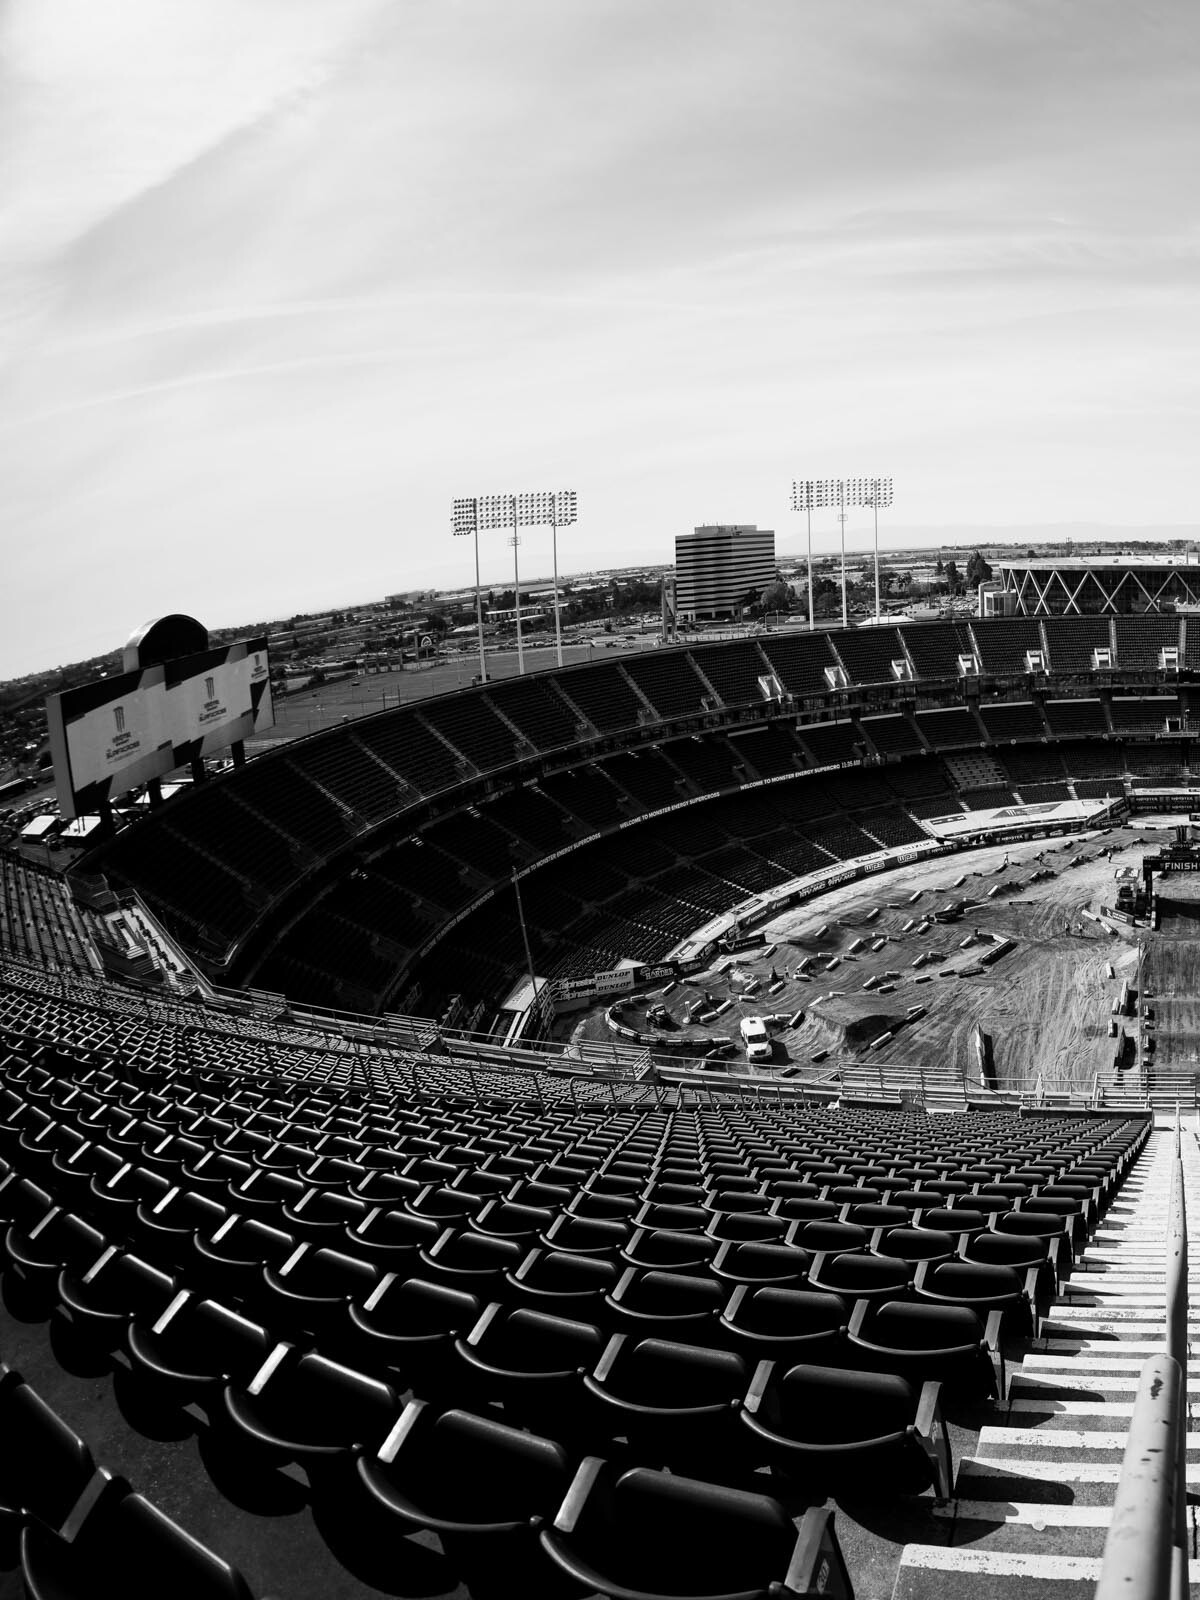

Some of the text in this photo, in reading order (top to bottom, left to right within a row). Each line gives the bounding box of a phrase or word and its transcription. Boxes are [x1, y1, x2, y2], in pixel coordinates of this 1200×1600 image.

[740, 780, 763, 790] WELCOME
[771, 773, 795, 783] MONSTER
[795, 768, 814, 778] ENERGY
[619, 816, 641, 829] WELCOME
[648, 806, 671, 819] MONSTER
[671, 801, 689, 811] ENERGY
[689, 792, 720, 805] SUPERCROSS
[1164, 862, 1198, 870] FINISH
[597, 971, 630, 980] DUNLOP
[598, 981, 632, 991] DUNLOP
